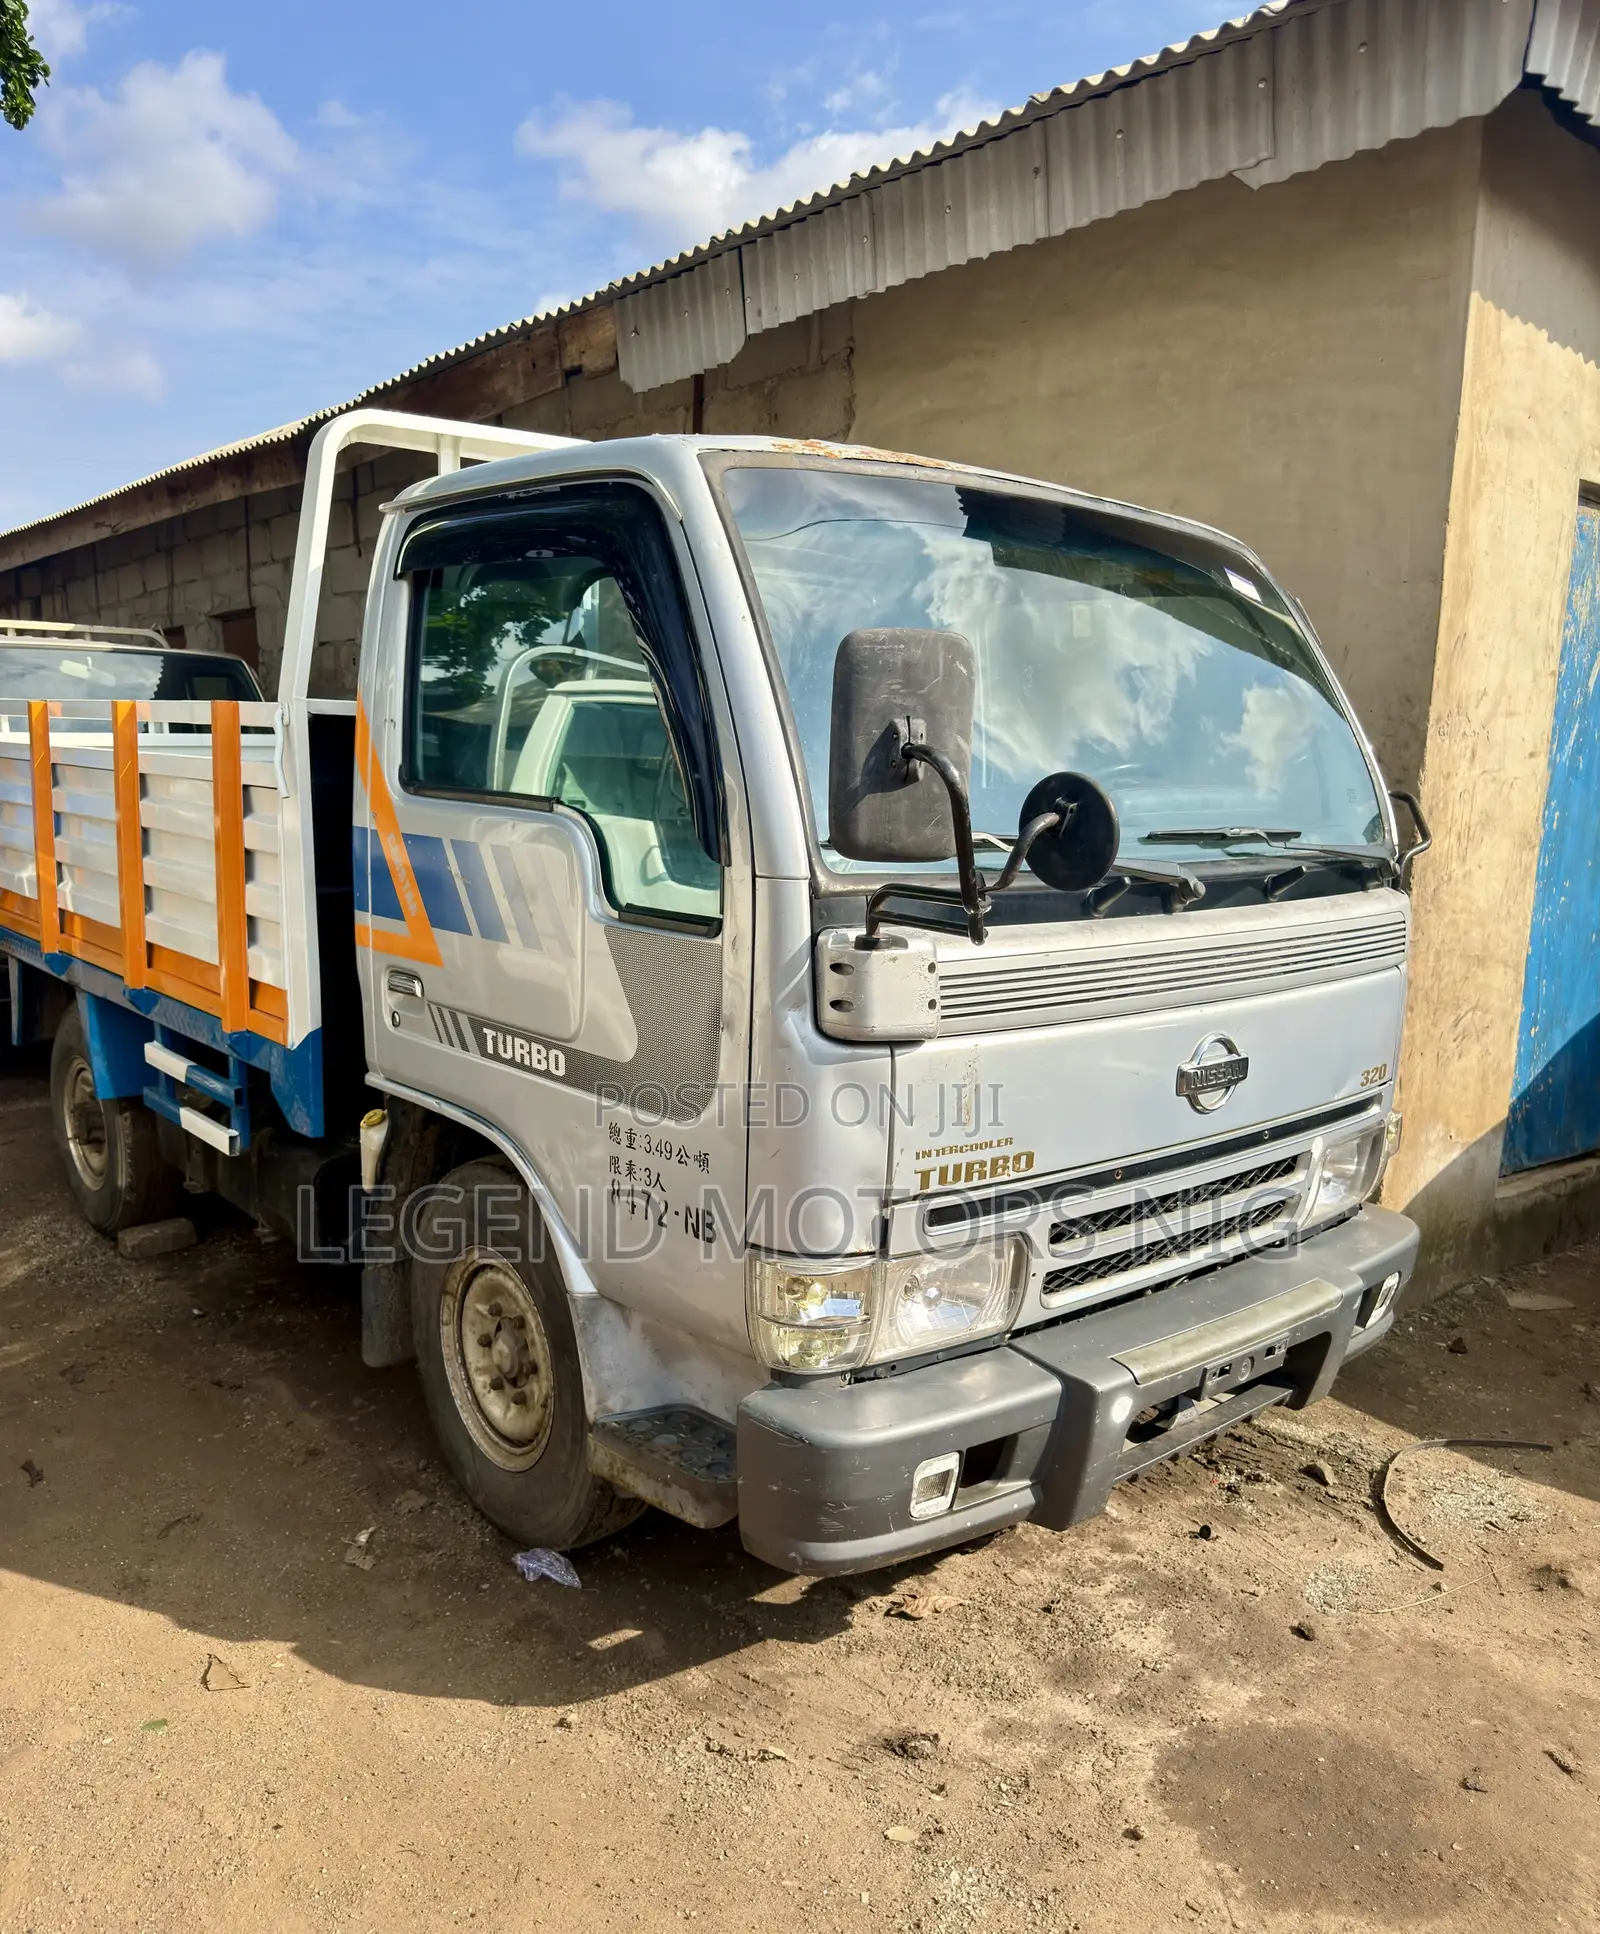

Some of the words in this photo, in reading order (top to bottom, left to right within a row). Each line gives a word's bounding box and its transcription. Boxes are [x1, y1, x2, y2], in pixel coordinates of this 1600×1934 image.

[482, 1027, 566, 1077] TURBO
[1191, 1061, 1244, 1088] NISSAN
[1360, 1063, 1387, 1087] 320
[915, 1136, 1014, 1161] INTERCOOLER
[914, 1150, 1035, 1191] TURBO
